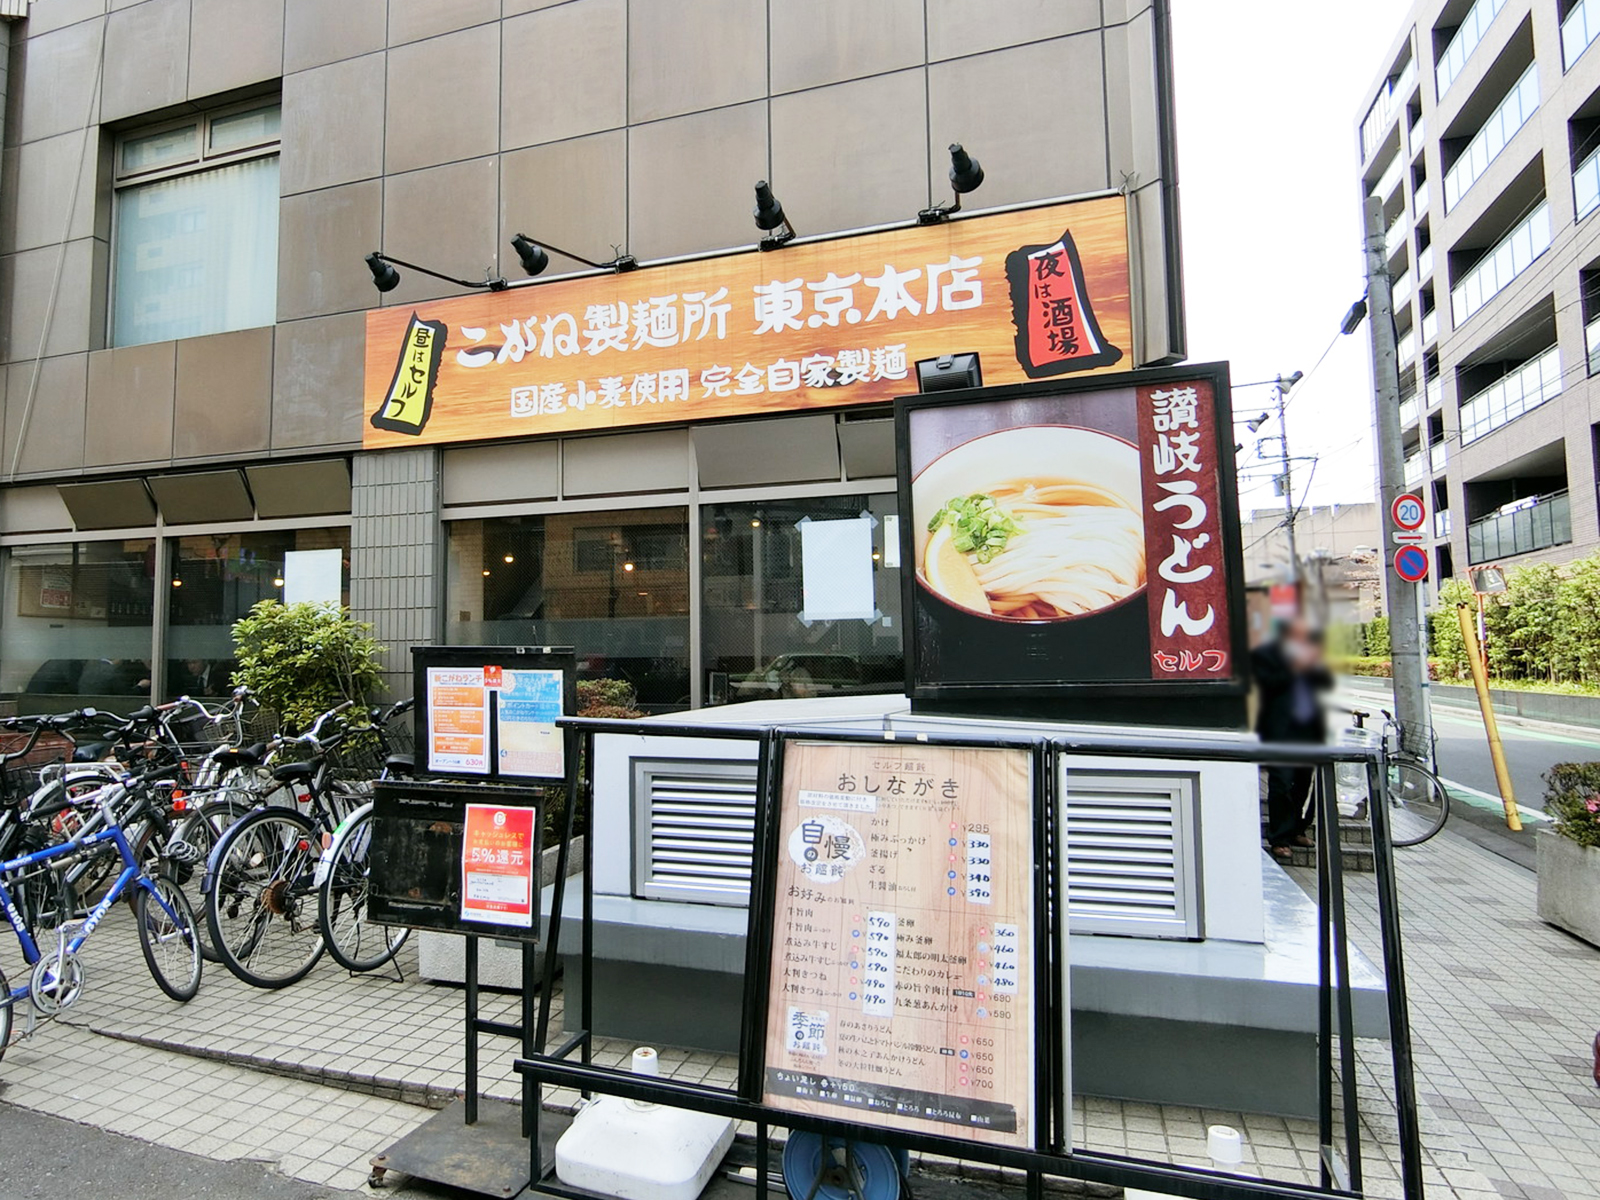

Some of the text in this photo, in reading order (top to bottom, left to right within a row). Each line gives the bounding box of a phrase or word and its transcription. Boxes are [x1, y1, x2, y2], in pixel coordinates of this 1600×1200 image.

[456, 255, 984, 368] こがね製麺所 東京本店
[1034, 251, 1079, 355] 夜は酒場
[390, 327, 431, 418] 昼はセルフ
[510, 343, 909, 418] 国産小麦使用 完全自家製麺
[1150, 387, 1215, 638] 讃岐うどん
[1400, 504, 1419, 521] 20
[1153, 649, 1227, 673] セルフ
[837, 772, 961, 799] おしながき
[802, 819, 851, 861] 自慢
